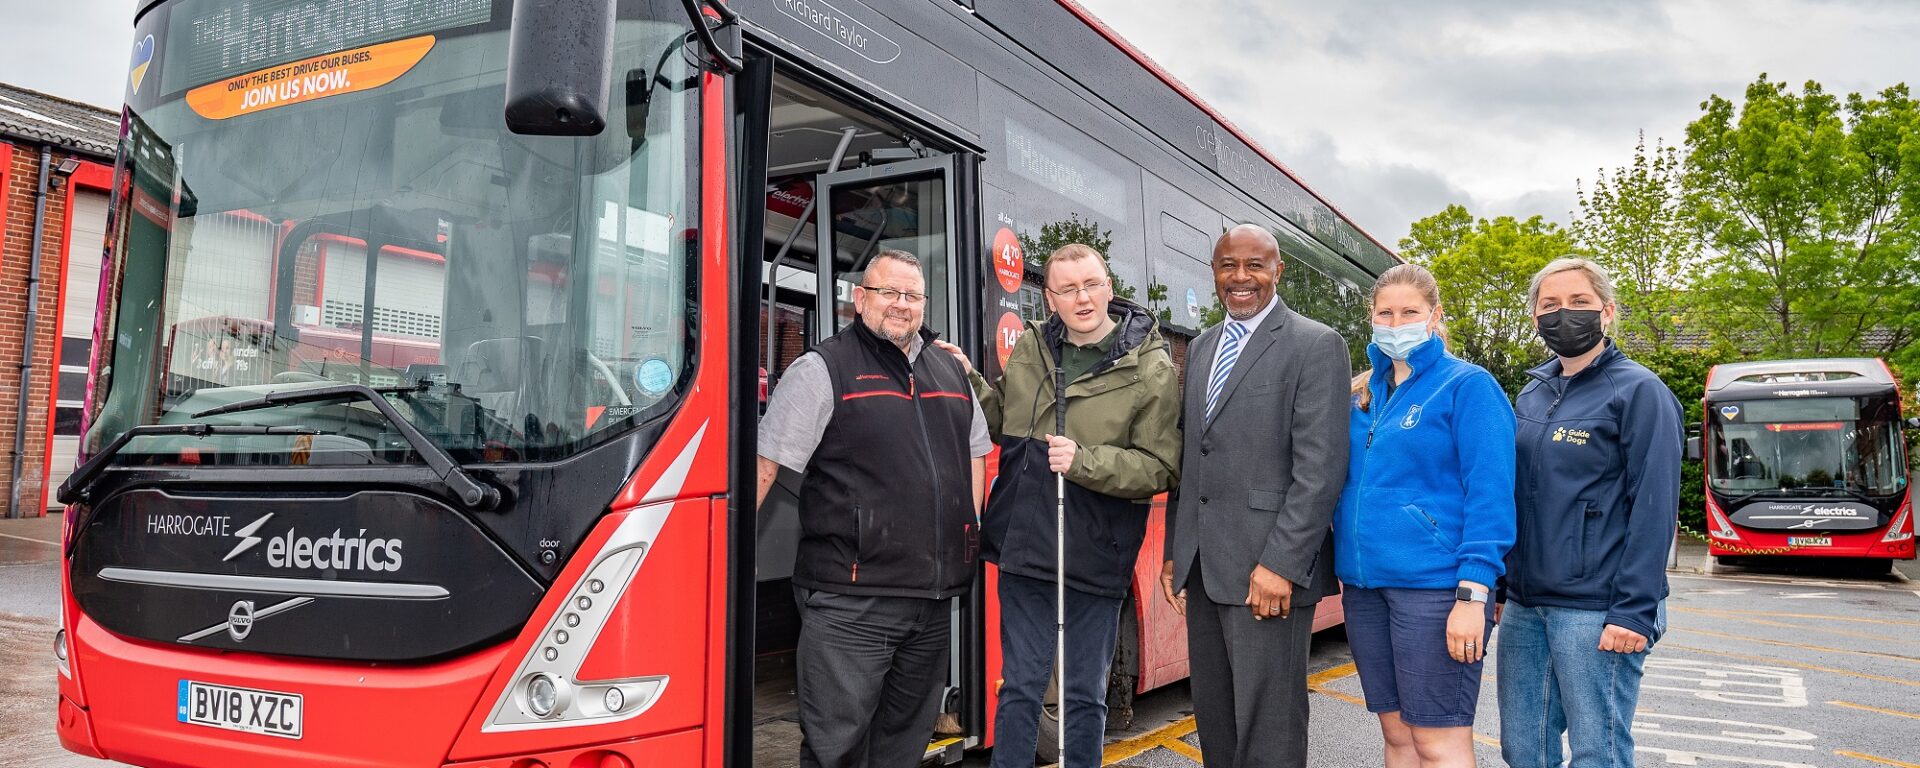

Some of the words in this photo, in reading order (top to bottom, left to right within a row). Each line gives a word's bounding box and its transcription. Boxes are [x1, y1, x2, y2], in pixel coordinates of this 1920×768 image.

[191, 14, 222, 45] THE
[221, 0, 408, 68] Harrogate
[833, 17, 868, 50] Taylor
[228, 79, 251, 92] ONLY
[252, 73, 268, 86] THE
[270, 68, 291, 82] BEST
[293, 61, 319, 76] DRIVE
[320, 57, 340, 69] OUR
[341, 51, 372, 66] BUSES.
[240, 84, 277, 110] JOIN
[279, 78, 300, 101] US
[302, 69, 351, 96] NOW.
[773, 190, 810, 209] electric
[1004, 214, 1014, 227] day
[1566, 435, 1587, 446] Dogs
[1568, 429, 1591, 438] Guide
[1814, 507, 1857, 516] electrics
[147, 513, 231, 537] HARROGATE
[267, 526, 403, 572] electrics
[539, 537, 560, 548] door
[195, 687, 242, 724] BV18
[249, 693, 294, 731] XZC
